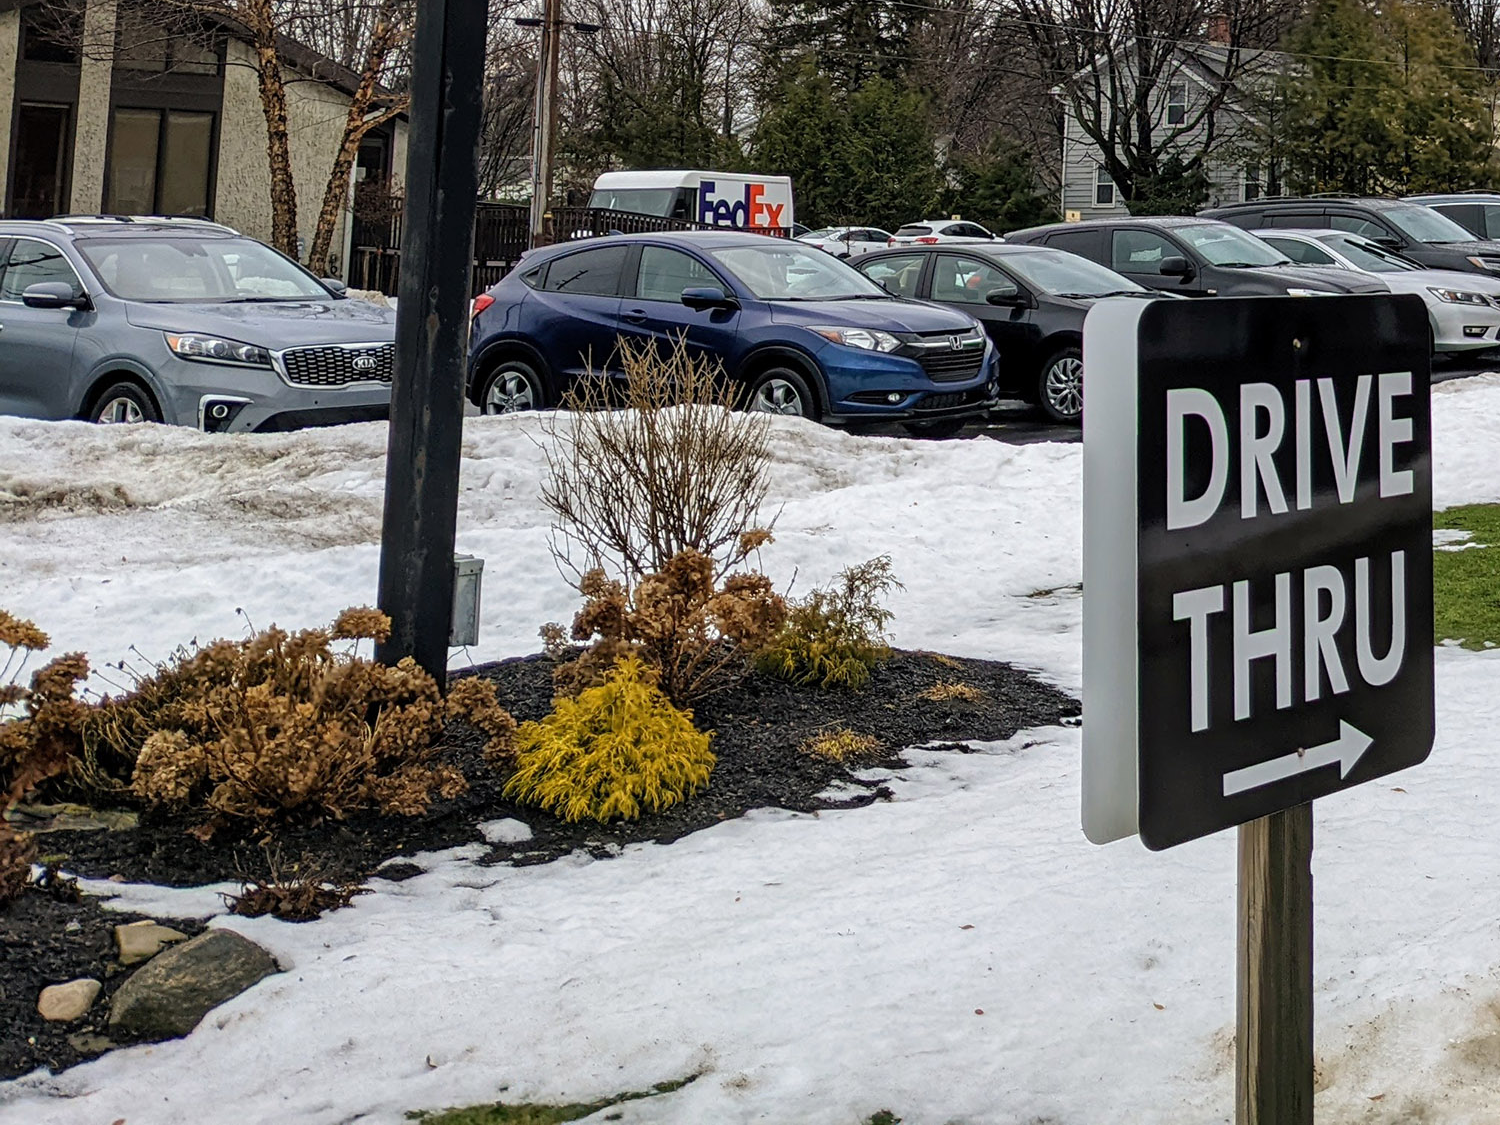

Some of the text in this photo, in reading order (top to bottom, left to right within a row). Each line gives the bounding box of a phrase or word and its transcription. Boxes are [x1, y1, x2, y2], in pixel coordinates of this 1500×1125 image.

[700, 181, 784, 227] FedEx
[355, 358, 376, 369] KIA
[1165, 371, 1414, 531] DRIVE
[1172, 549, 1406, 734] THRU
